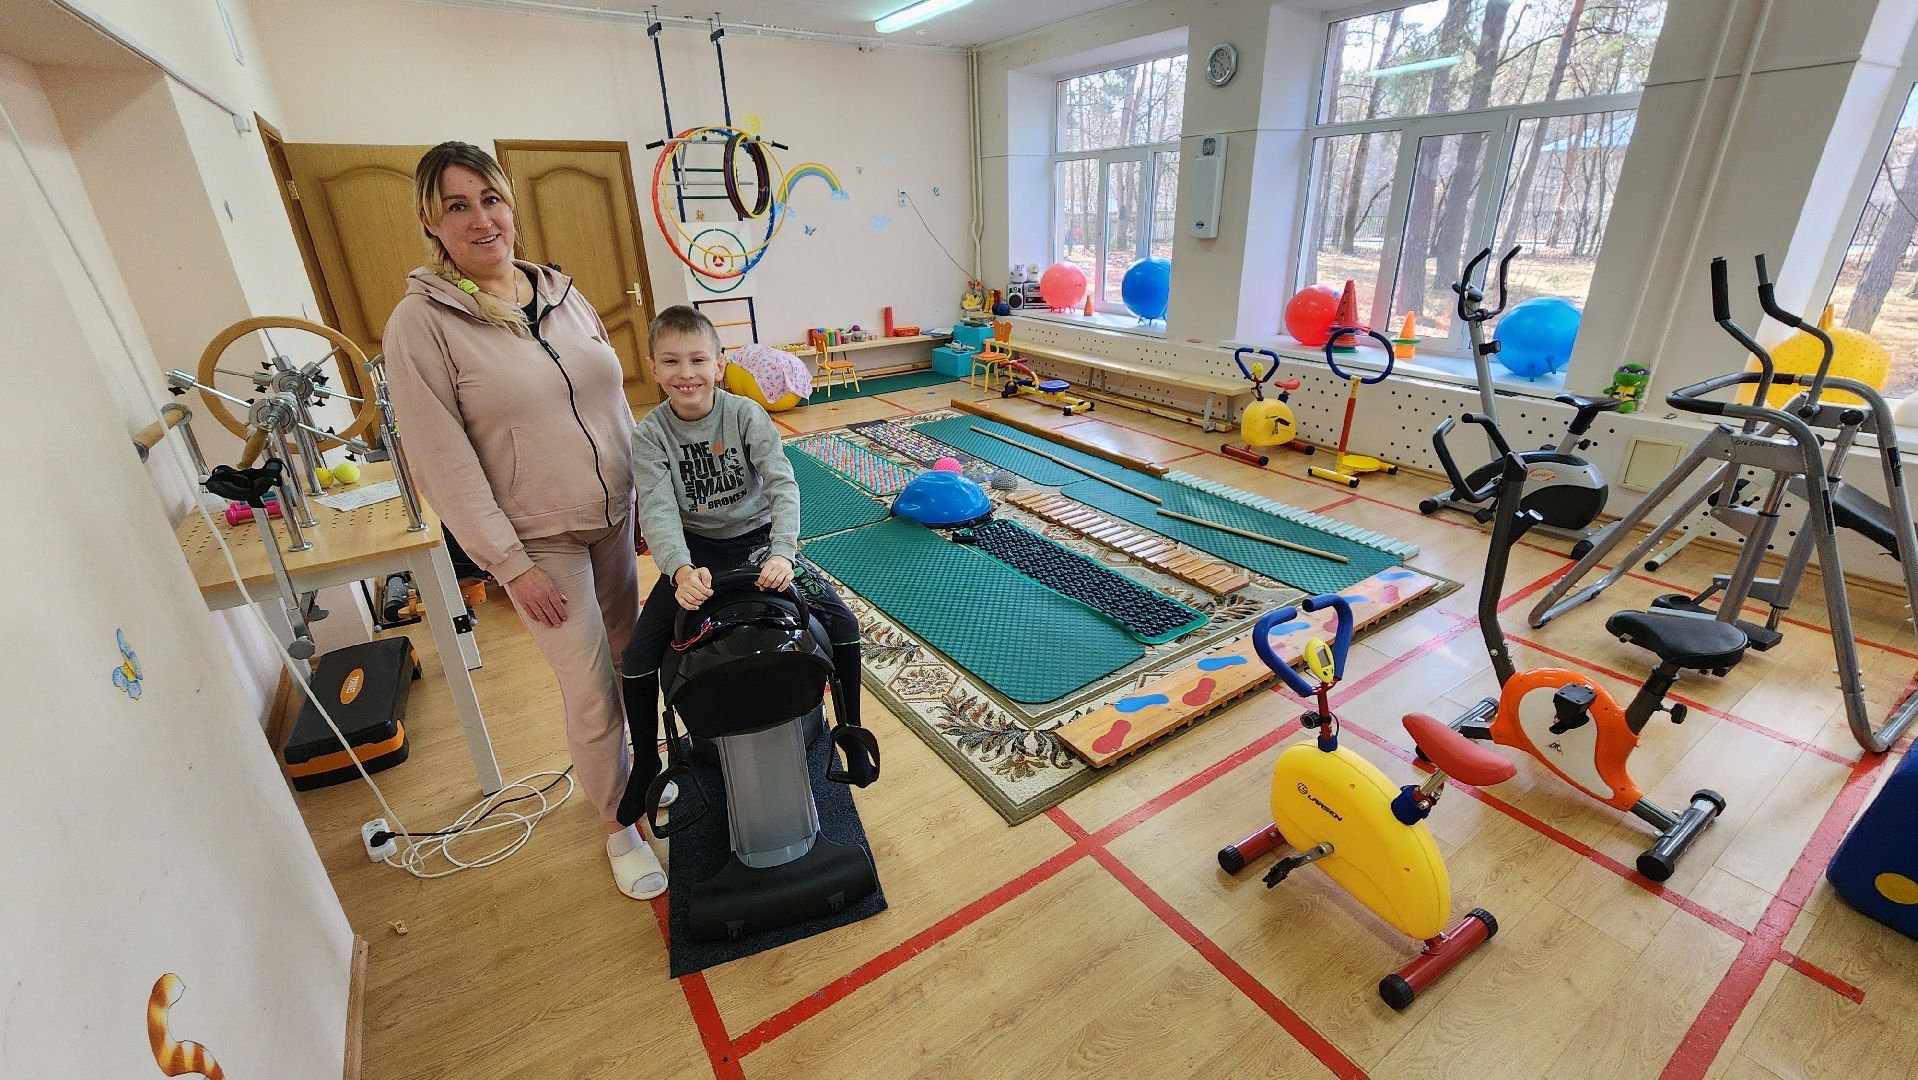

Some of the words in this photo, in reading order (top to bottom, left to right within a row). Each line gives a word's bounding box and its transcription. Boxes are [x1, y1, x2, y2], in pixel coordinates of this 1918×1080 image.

[679, 441, 713, 460] THE
[695, 466, 745, 498] MADE
[707, 489, 748, 510] BROKEN
